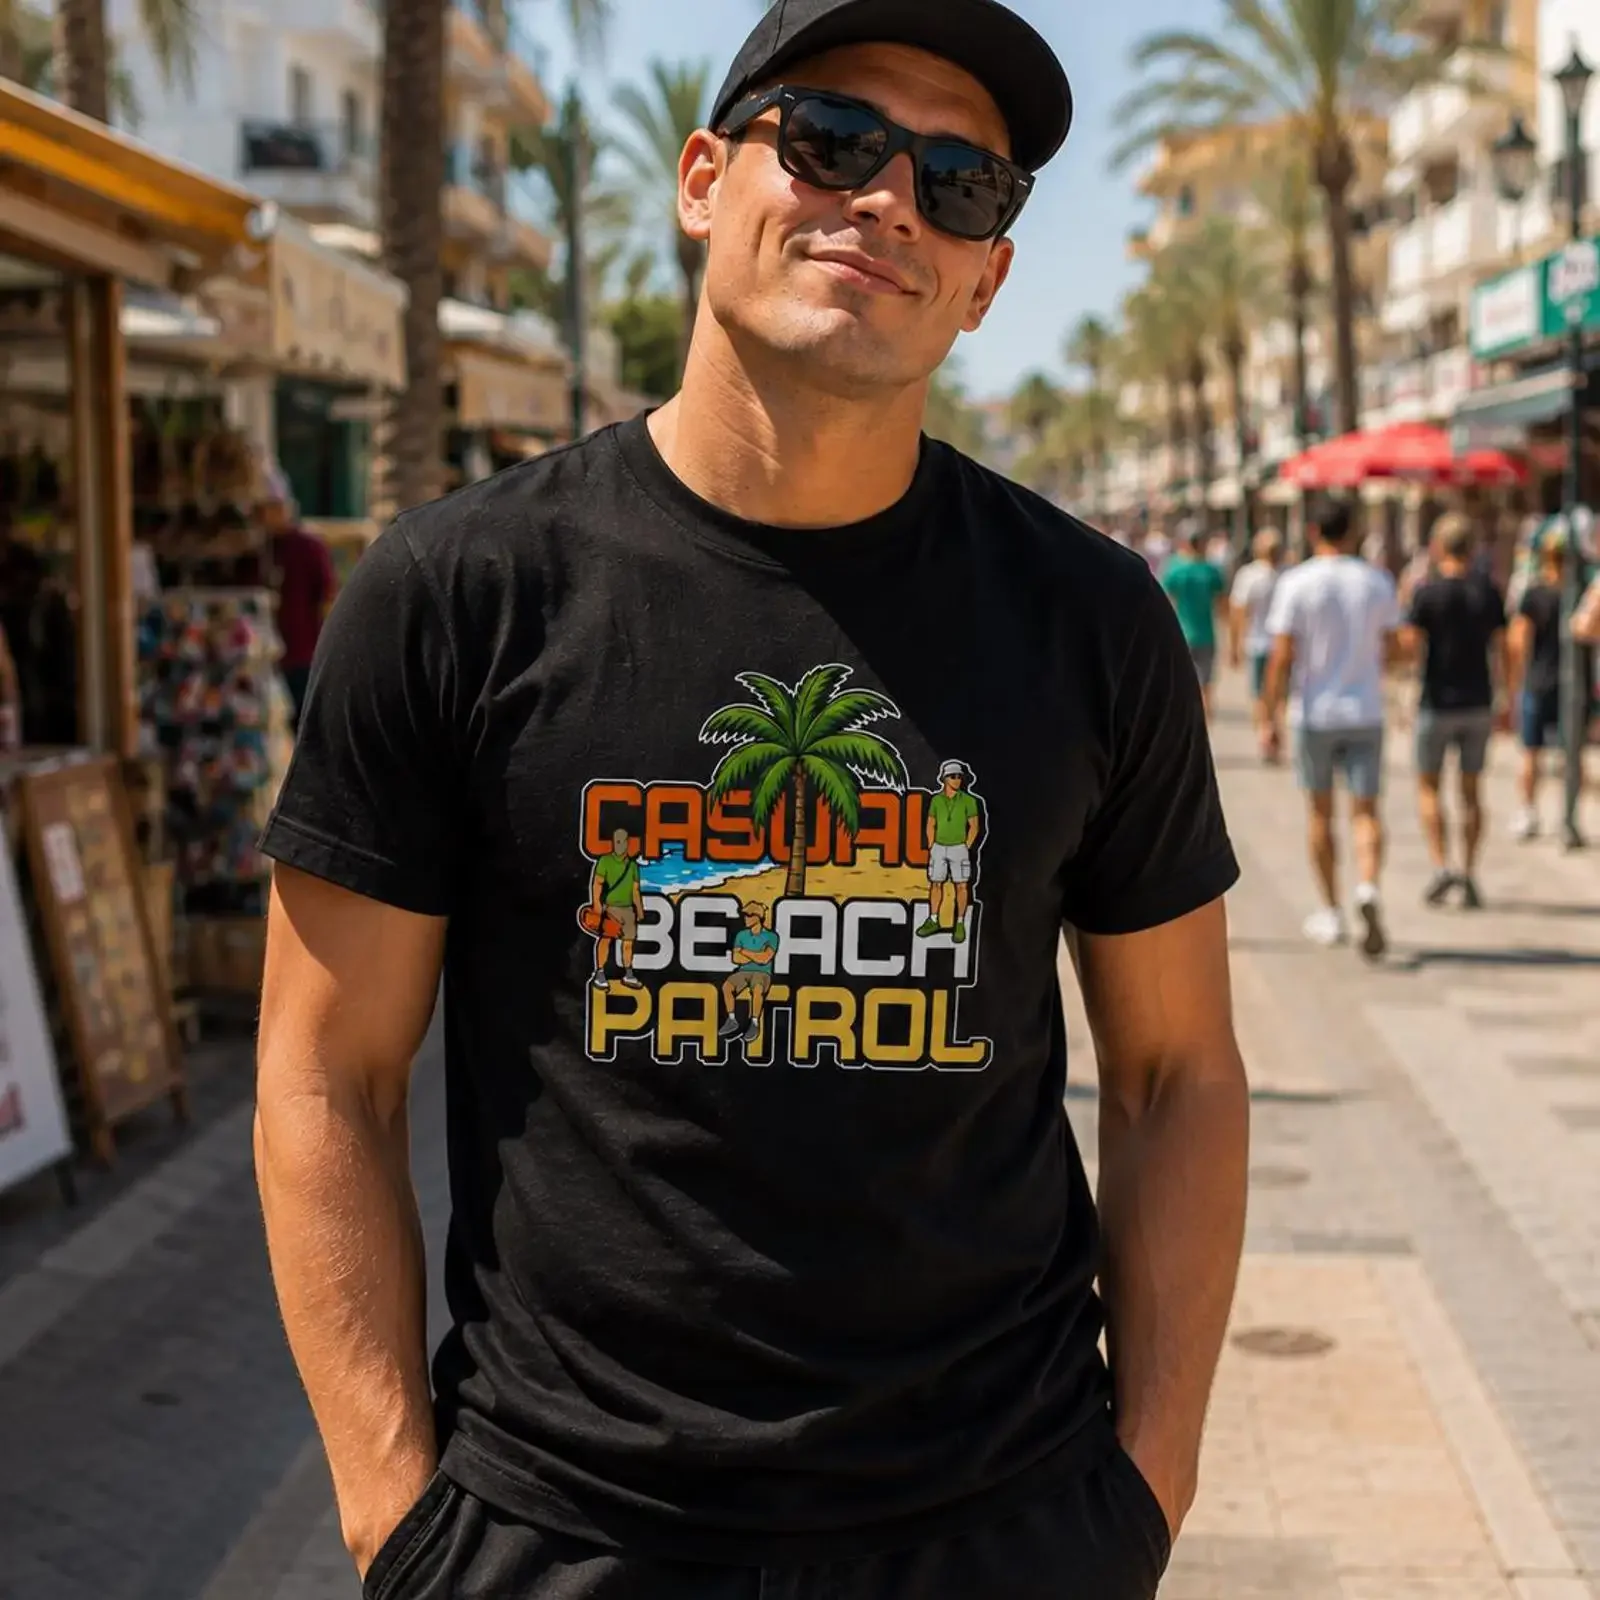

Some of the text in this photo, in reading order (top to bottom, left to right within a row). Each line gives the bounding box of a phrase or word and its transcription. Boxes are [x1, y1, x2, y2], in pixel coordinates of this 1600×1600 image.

[585, 785, 930, 867] CASUAL
[615, 896, 973, 978] BEACH
[590, 979, 986, 1063] PATROL
